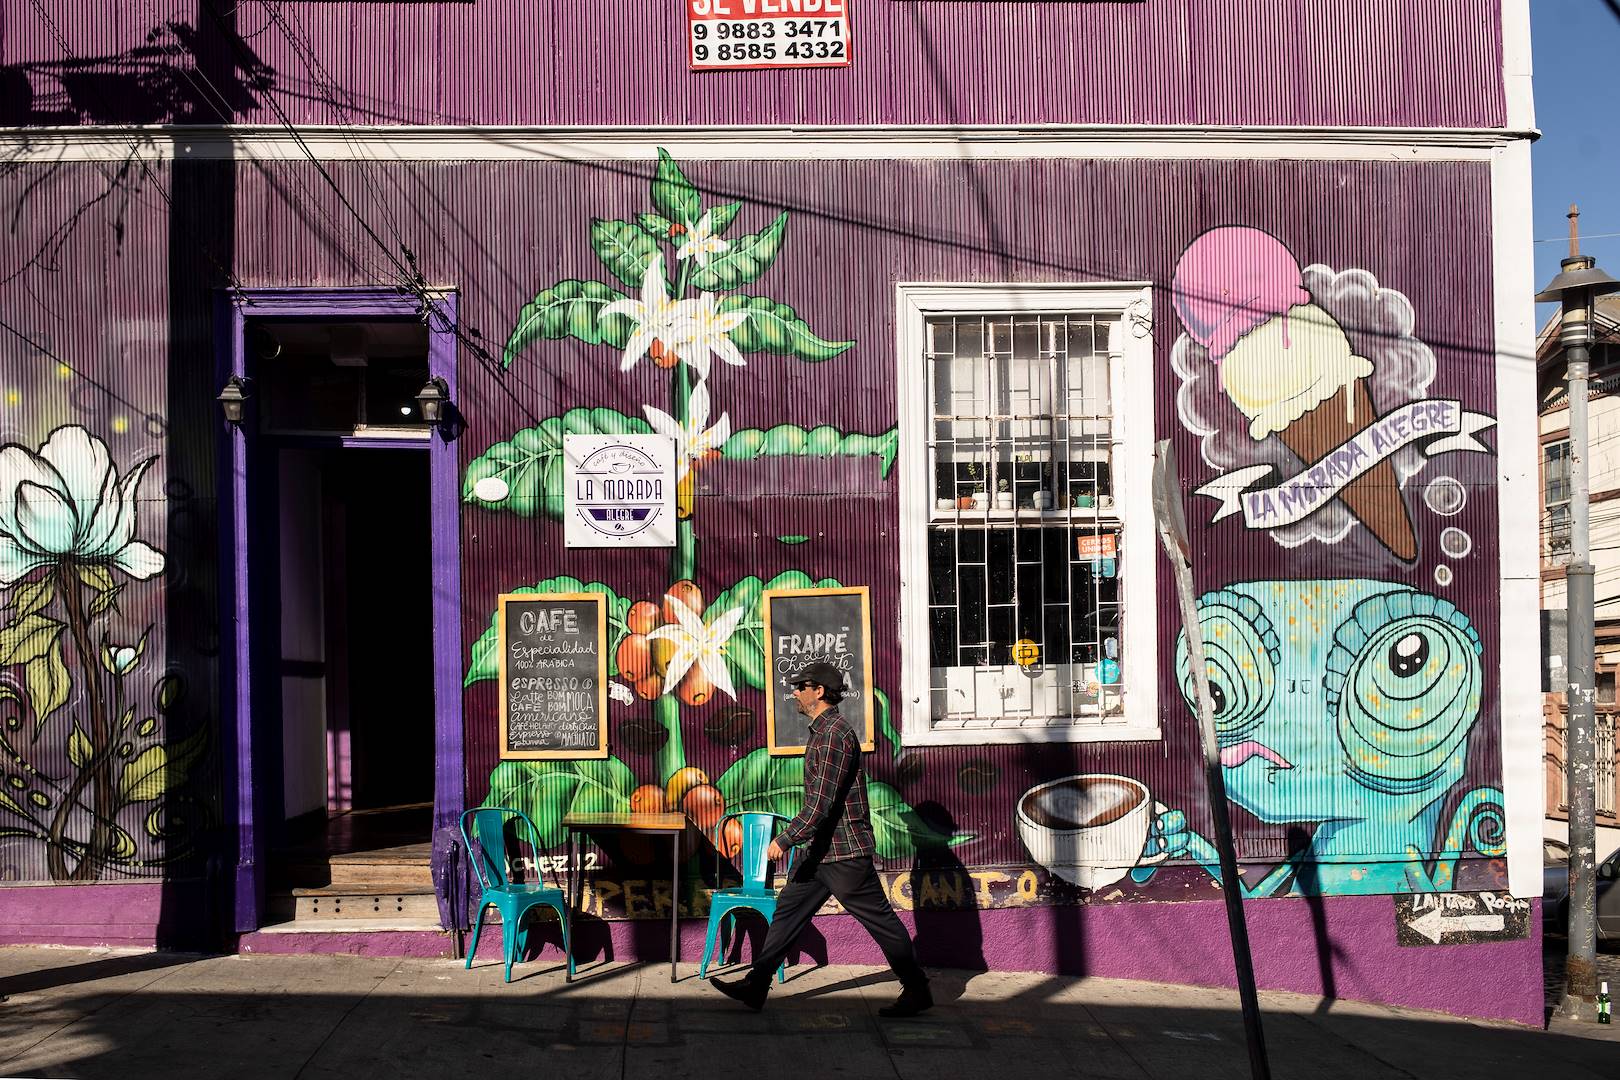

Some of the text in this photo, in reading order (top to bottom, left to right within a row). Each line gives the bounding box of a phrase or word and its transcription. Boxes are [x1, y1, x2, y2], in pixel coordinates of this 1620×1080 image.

[694, 21, 841, 40] 9 9883 3471
[695, 41, 844, 60] 9 8585 4332
[1249, 401, 1455, 521] LA MORADA ALEGRE
[577, 479, 662, 500] LA MORADA
[606, 508, 634, 521] ALEGRE
[511, 640, 597, 661] Especialidad
